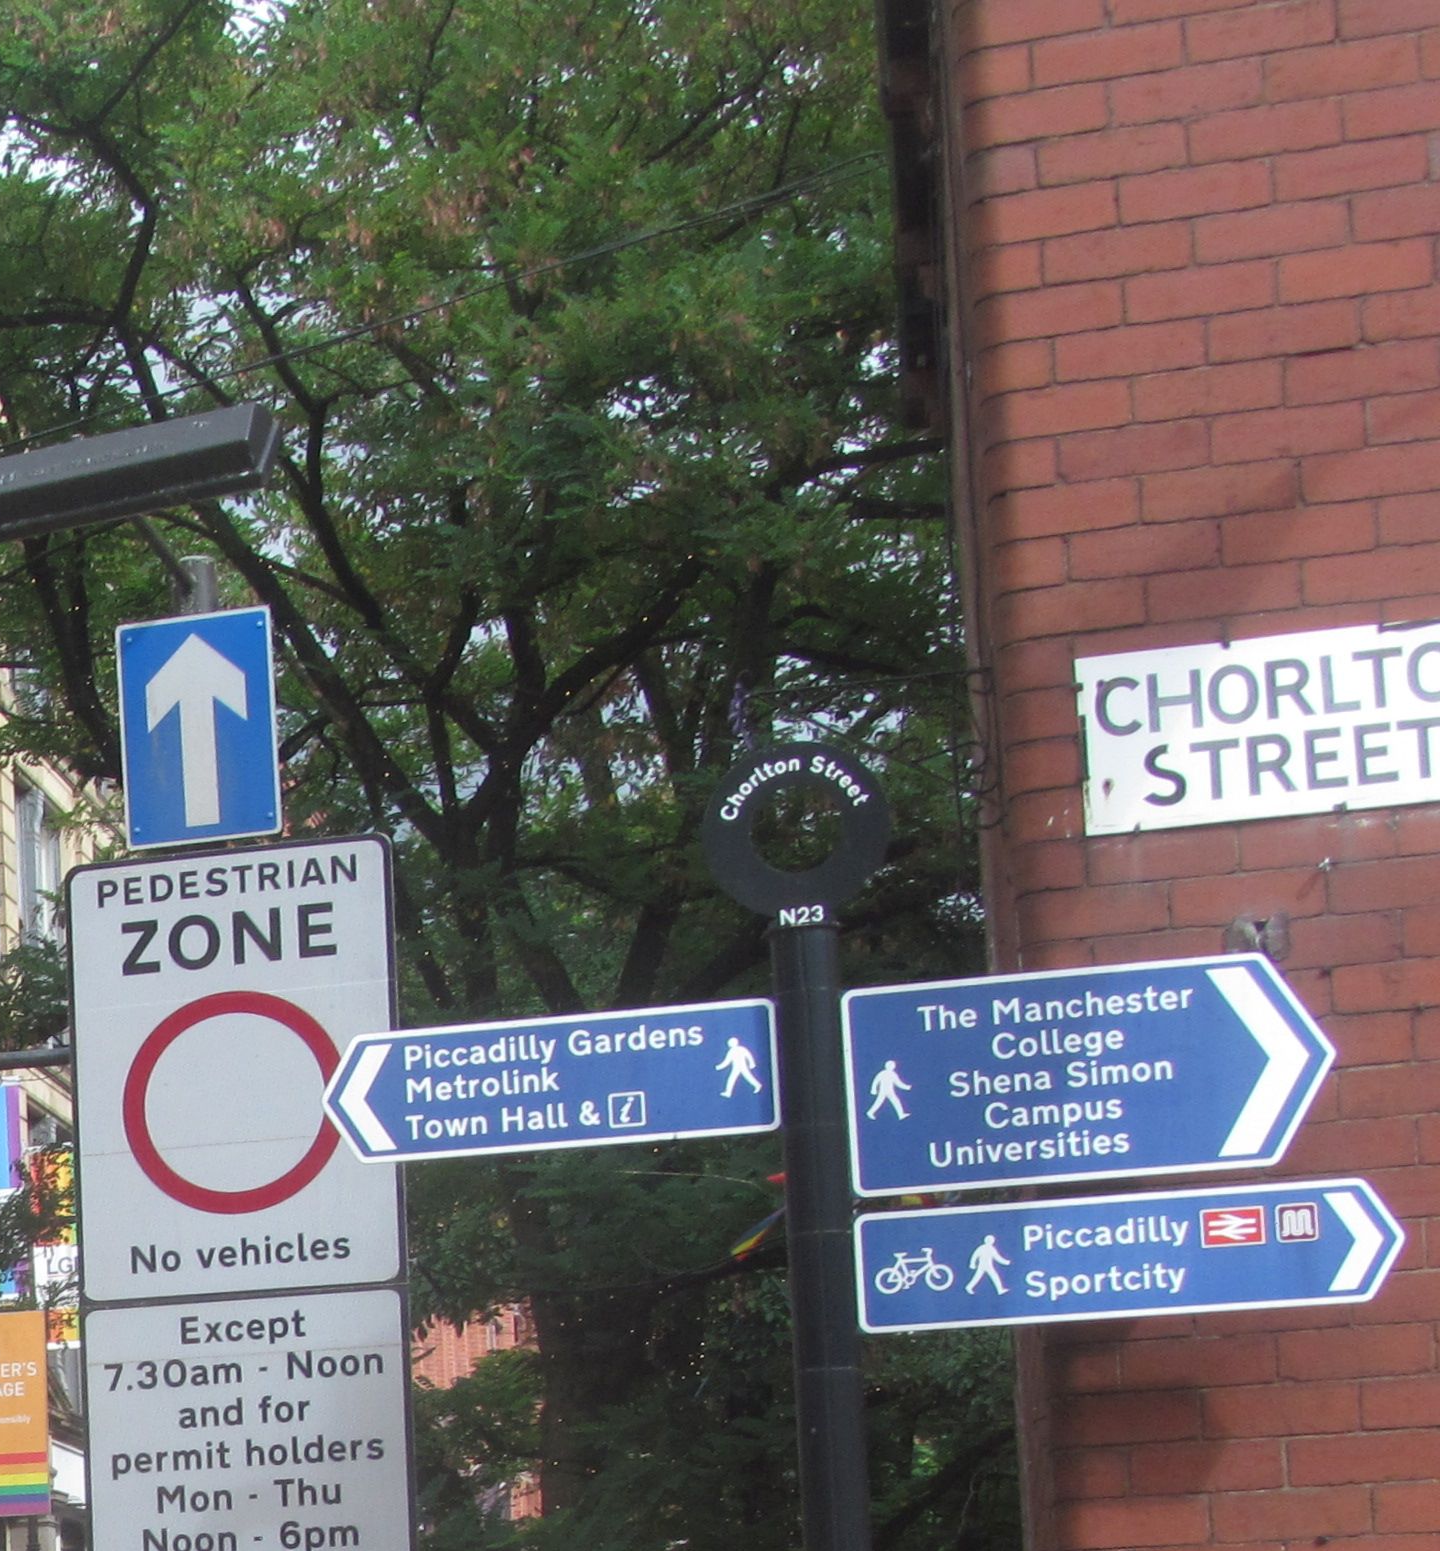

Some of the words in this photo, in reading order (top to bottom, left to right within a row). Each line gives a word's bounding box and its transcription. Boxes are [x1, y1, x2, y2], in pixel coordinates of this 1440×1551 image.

[1143, 717, 1440, 807] STREET
[720, 757, 801, 821] Chorlton
[809, 756, 870, 807] Street
[97, 853, 357, 908] PEDESTRIAN
[779, 905, 825, 926] N23
[121, 901, 338, 976] ZONE
[917, 1005, 978, 1033] The
[992, 986, 1194, 1025] Manchester
[403, 1034, 557, 1071] Piccadilly
[568, 1023, 705, 1058] Gardens
[991, 1028, 1124, 1061] College
[405, 1067, 560, 1104] Metrolink
[949, 1068, 1052, 1100] Shena
[1066, 1059, 1174, 1089] Simon
[404, 1112, 489, 1140] Town
[501, 1103, 568, 1134] Hall
[579, 1102, 601, 1127] &
[984, 1096, 1123, 1130] Campus
[929, 1130, 1131, 1169] Universities
[1023, 1216, 1190, 1252] Piccadilly
[130, 1245, 181, 1275] No
[197, 1234, 351, 1269] vehicles
[1025, 1262, 1186, 1300] Sportcity
[180, 1309, 306, 1345] Except
[104, 1358, 243, 1392] 7.30am
[287, 1351, 384, 1380] Noon
[179, 1397, 244, 1429] and
[258, 1395, 310, 1423] for
[112, 1441, 231, 1480] permit
[246, 1434, 385, 1466] holders
[156, 1485, 233, 1514] Mon
[274, 1479, 342, 1507] Thu
